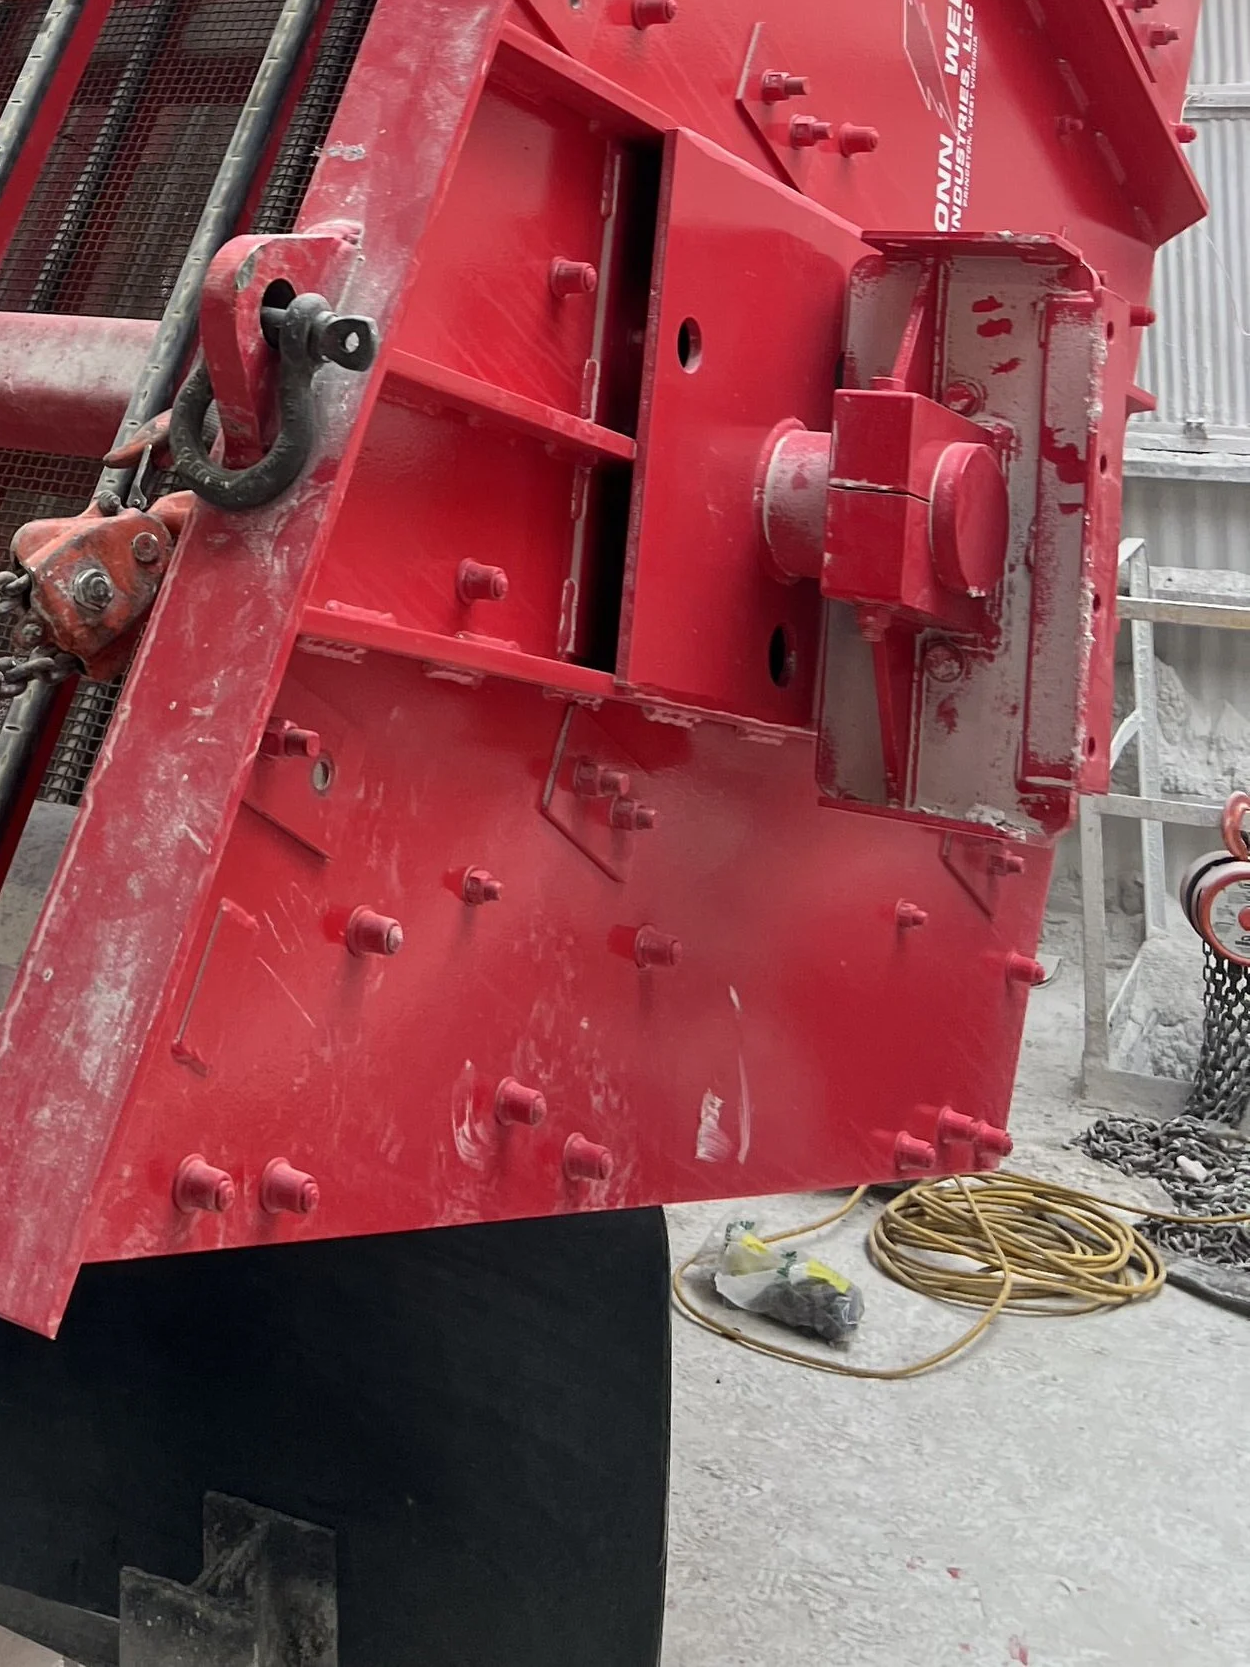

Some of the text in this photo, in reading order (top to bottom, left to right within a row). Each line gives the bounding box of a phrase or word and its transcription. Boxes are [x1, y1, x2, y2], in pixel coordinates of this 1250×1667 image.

[962, 3, 974, 53] LLC
[969, 35, 979, 90] VIRGINIA
[967, 91, 975, 128] WEST
[934, 133, 954, 232] ONN
